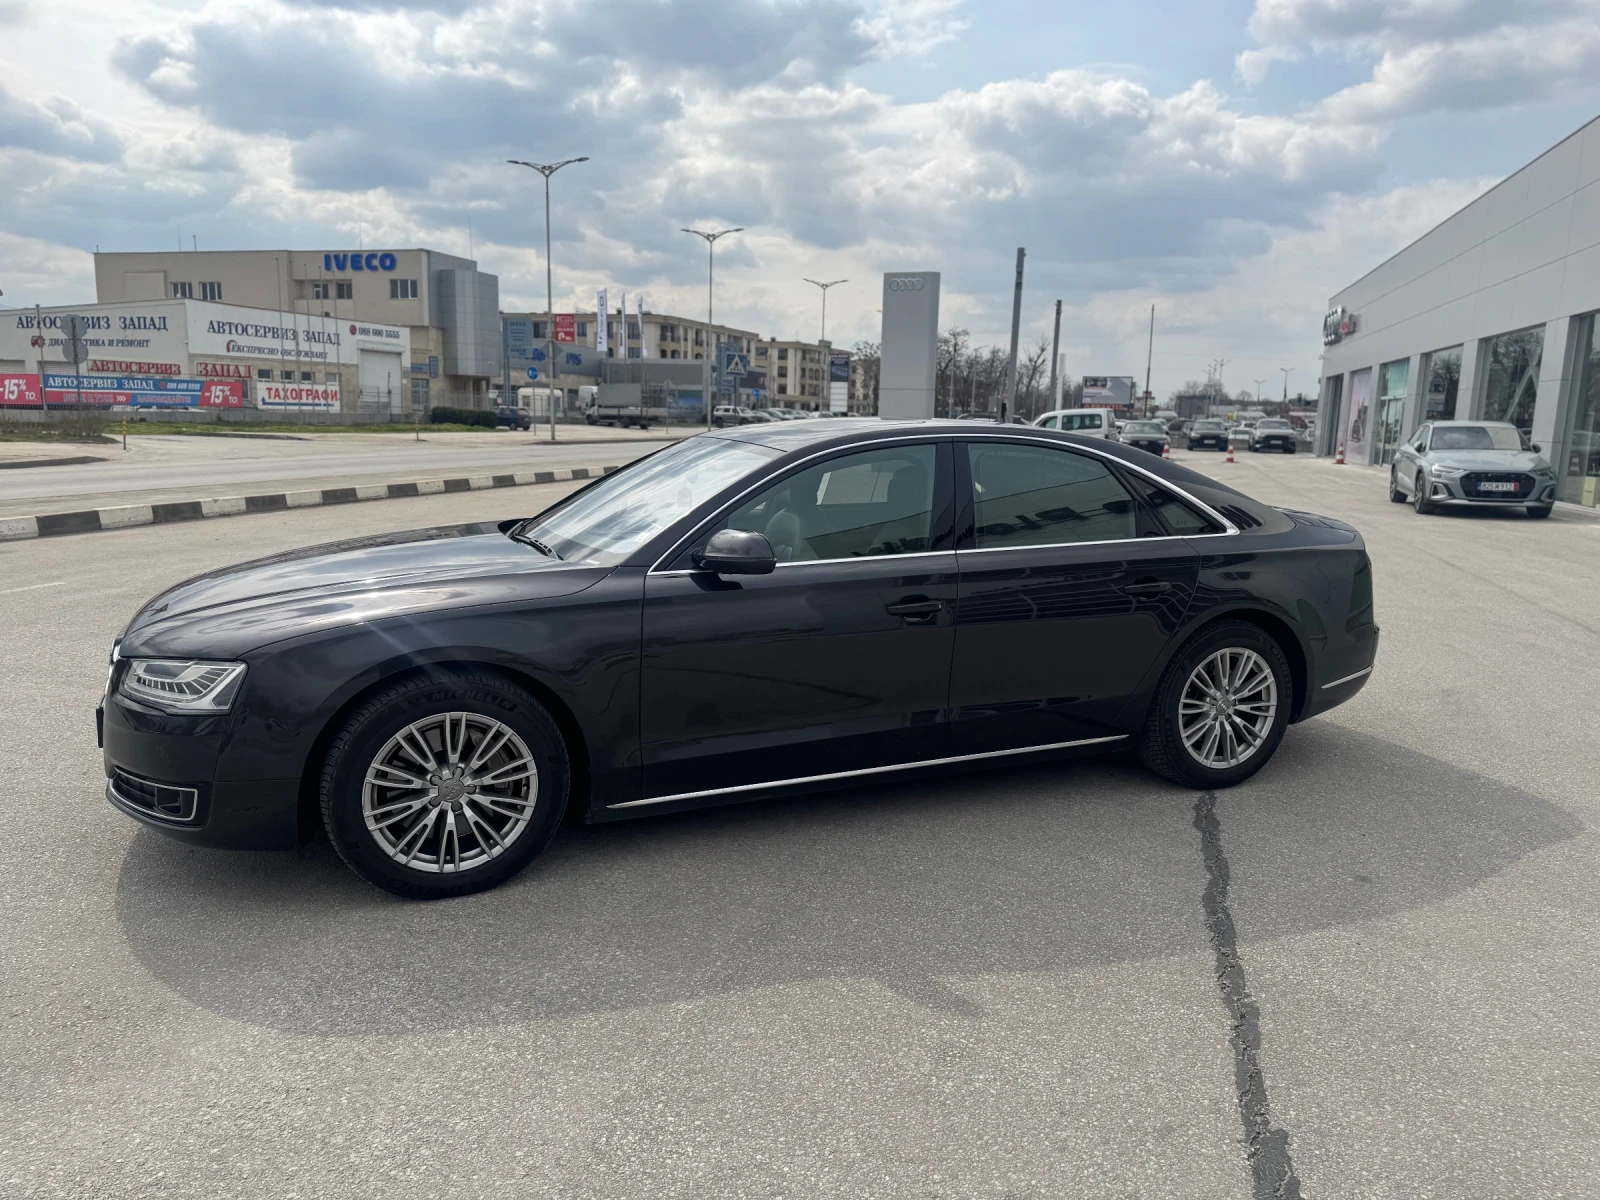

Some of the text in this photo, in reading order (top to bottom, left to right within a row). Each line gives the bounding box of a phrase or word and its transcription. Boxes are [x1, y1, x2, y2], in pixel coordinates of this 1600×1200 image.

[324, 253, 396, 272] IVECO
[16, 315, 168, 331] АВТОСВИЗ ЗАПАД
[207, 320, 341, 346] АВТОСЕРВИЗ ЗАПАД
[358, 327, 400, 339] 088 600 5555
[107, 339, 114, 347] И
[115, 339, 151, 347] РЕМОНТ
[231, 344, 279, 356] ЕКСПРЕСНО
[90, 360, 253, 379] АВТОСЕРВИЗ ЗАПАД
[122, 379, 154, 390] ЗАПАД
[205, 385, 230, 404] -15%
[266, 387, 338, 402] ТАХОГРАФИ
[432, 690, 513, 711] MICHELIN
